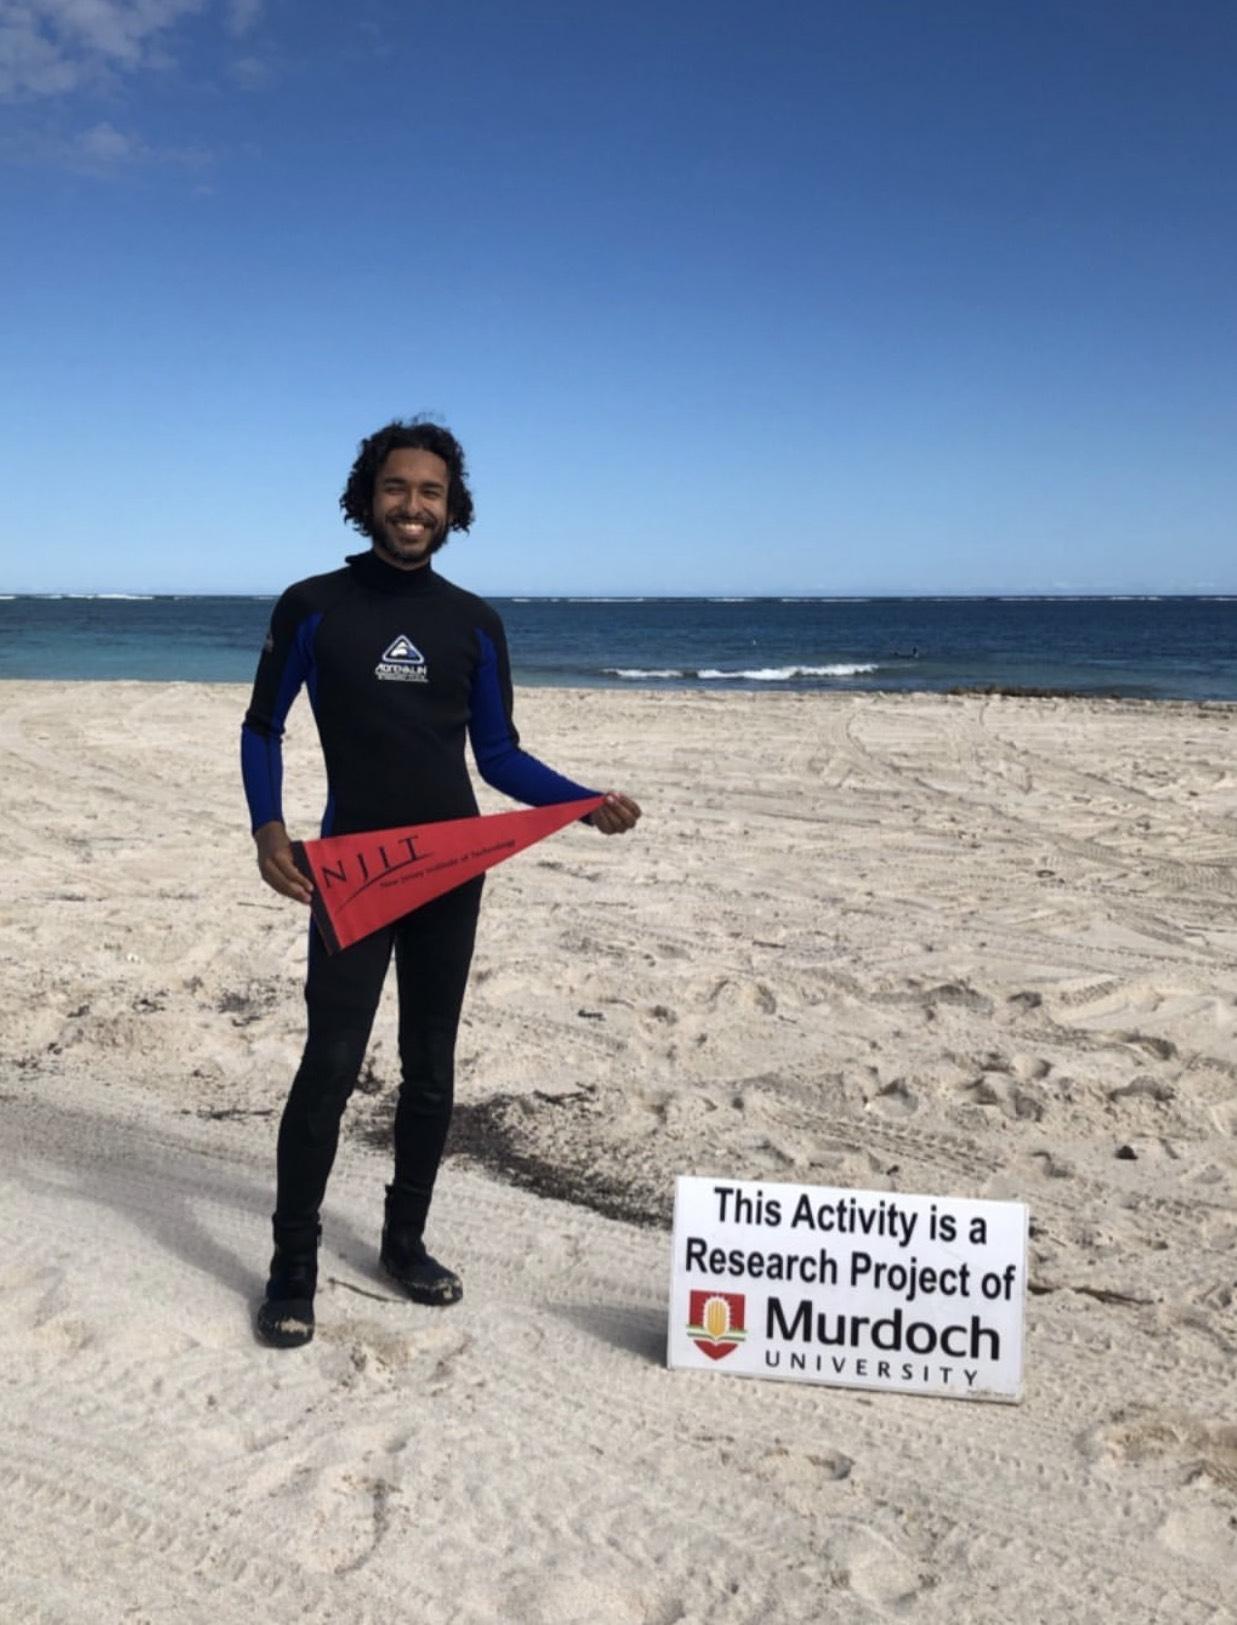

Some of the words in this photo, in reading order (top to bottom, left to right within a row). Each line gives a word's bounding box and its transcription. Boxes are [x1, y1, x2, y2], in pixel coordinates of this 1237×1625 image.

[321, 834, 419, 889] NJIT
[714, 1187, 782, 1227] This
[791, 1194, 918, 1248] Activity
[930, 1204, 957, 1242] is
[969, 1217, 987, 1245] a
[685, 1237, 838, 1285] Research
[850, 1251, 970, 1302] Project
[981, 1265, 1016, 1301] of
[766, 1297, 1000, 1361] Murdoch
[765, 1350, 978, 1387] UNIVERSITY
